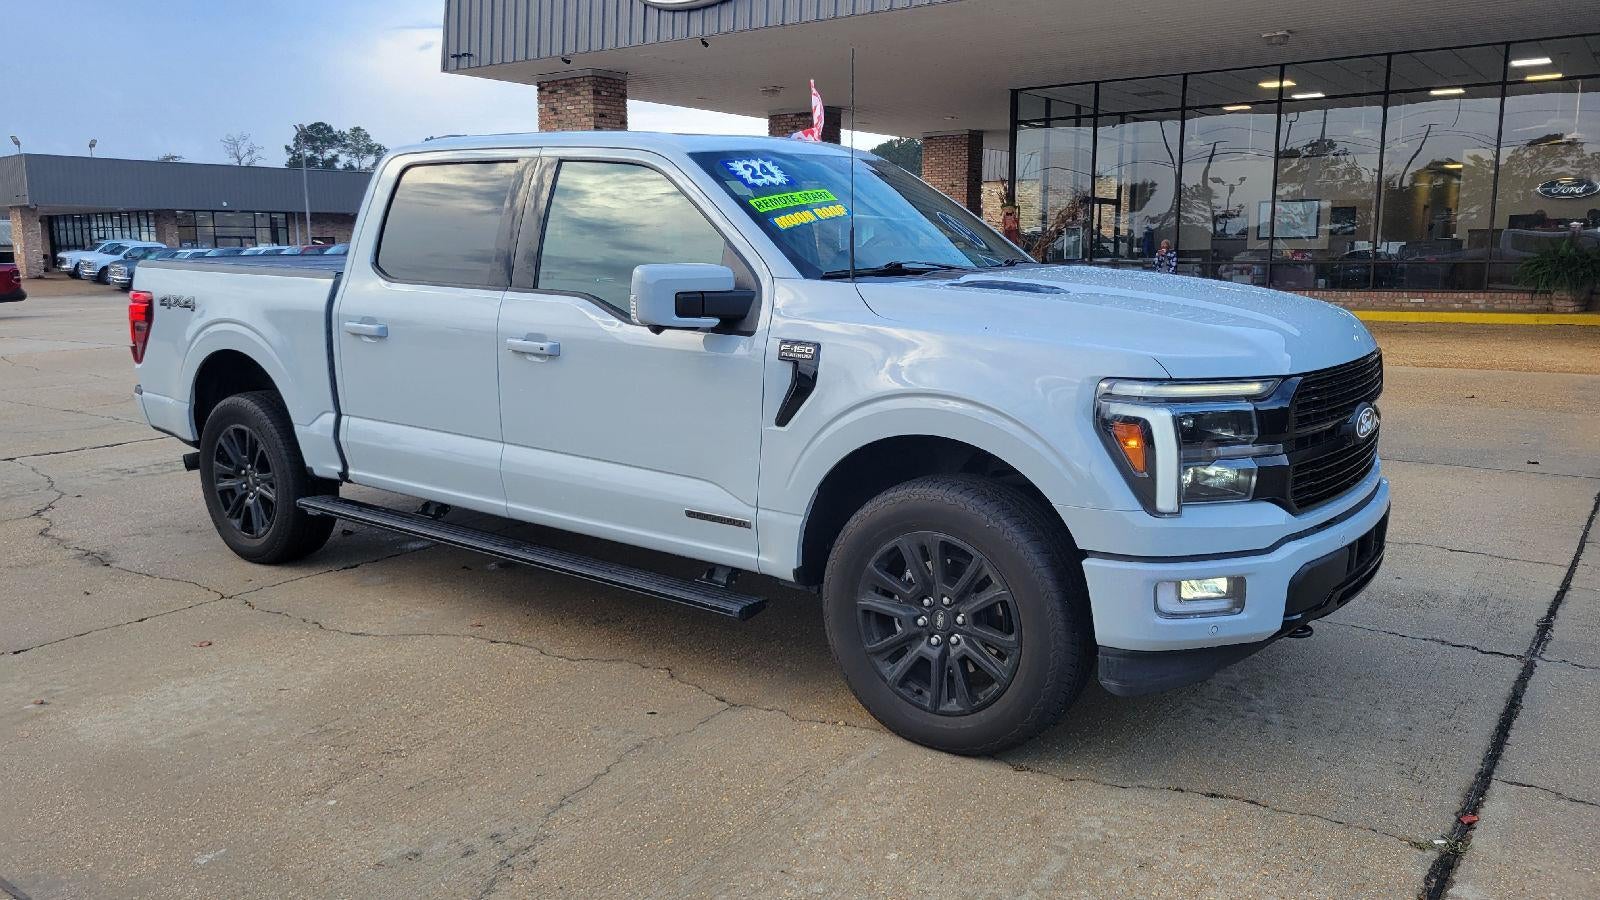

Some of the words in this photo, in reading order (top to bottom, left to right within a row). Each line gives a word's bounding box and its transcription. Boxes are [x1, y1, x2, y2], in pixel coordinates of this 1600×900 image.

[742, 163, 777, 181] 24
[1550, 182, 1588, 194] Ford
[754, 194, 799, 210] REMOTE
[800, 190, 831, 204] START
[780, 344, 815, 355] F-150
[781, 351, 813, 360] PLATINUM
